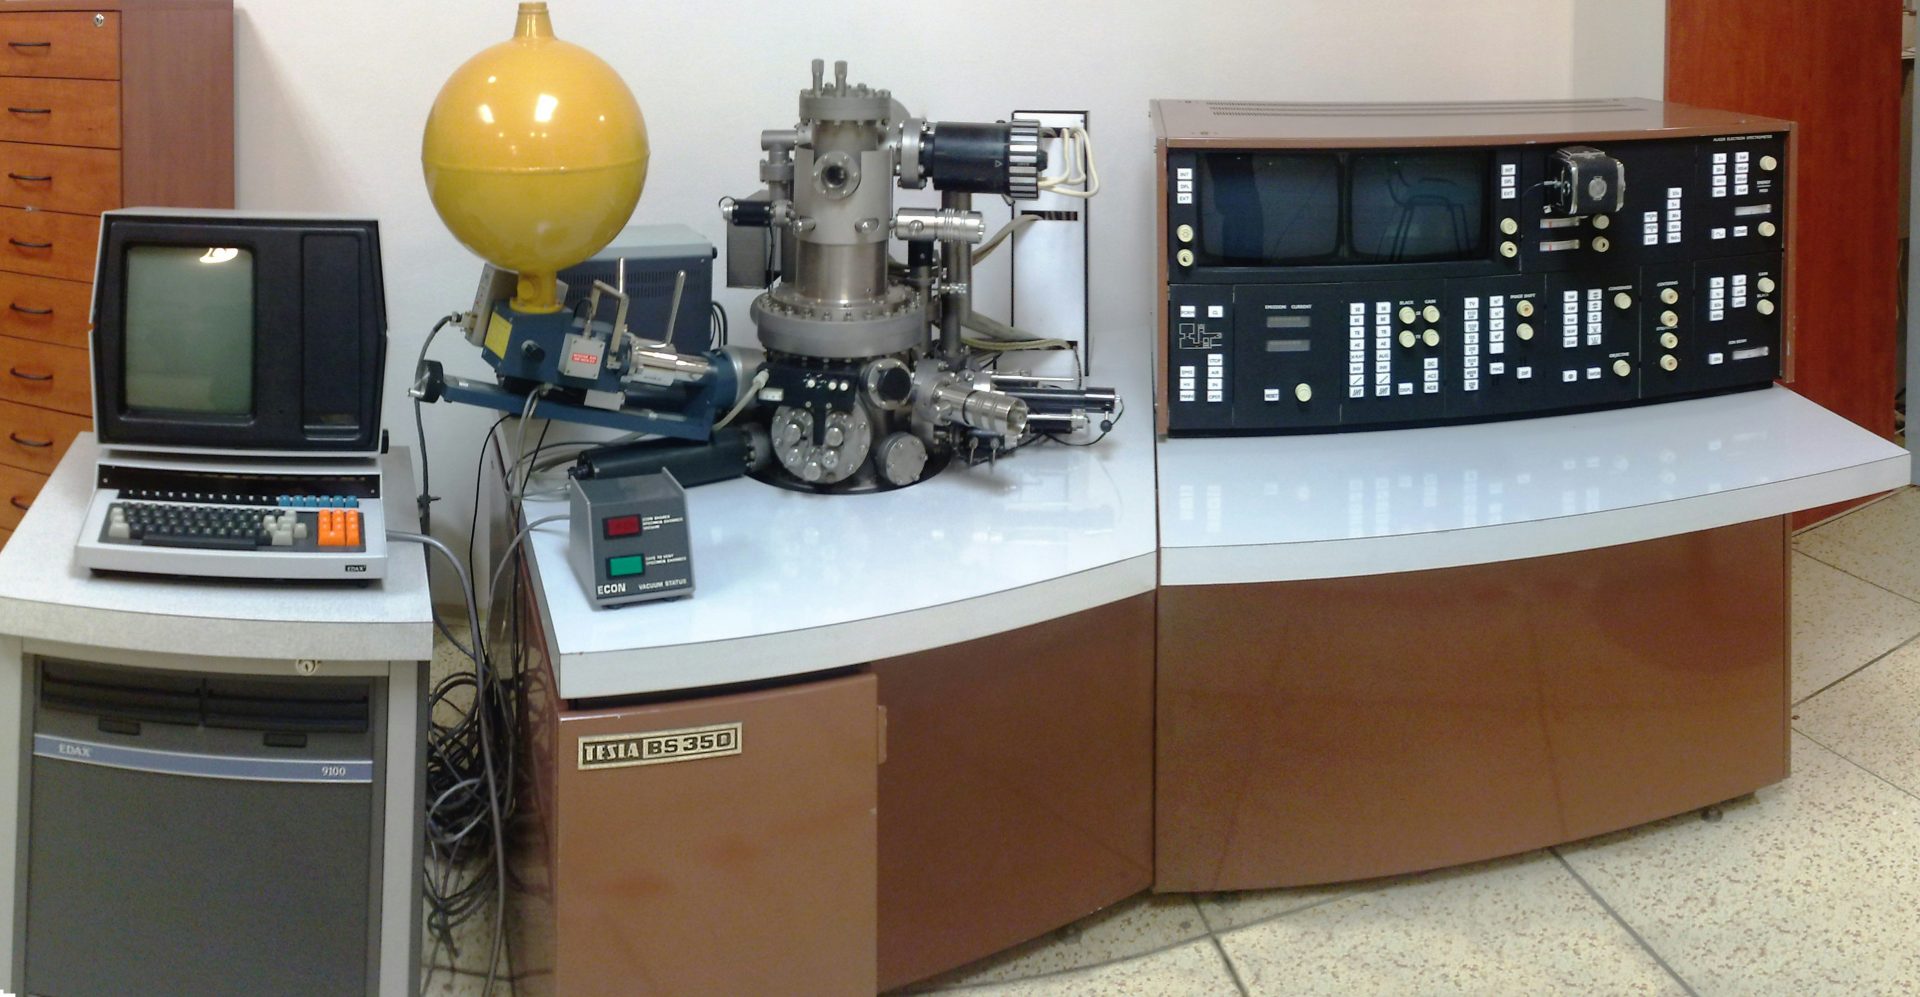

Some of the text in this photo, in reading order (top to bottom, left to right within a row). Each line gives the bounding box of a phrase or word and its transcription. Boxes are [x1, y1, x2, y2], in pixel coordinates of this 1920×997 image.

[597, 578, 687, 595] ECON VACUUM STATUS
[58, 743, 90, 758] EDAX
[584, 732, 732, 761] TESLA BS 350
[322, 766, 346, 776] 9100
